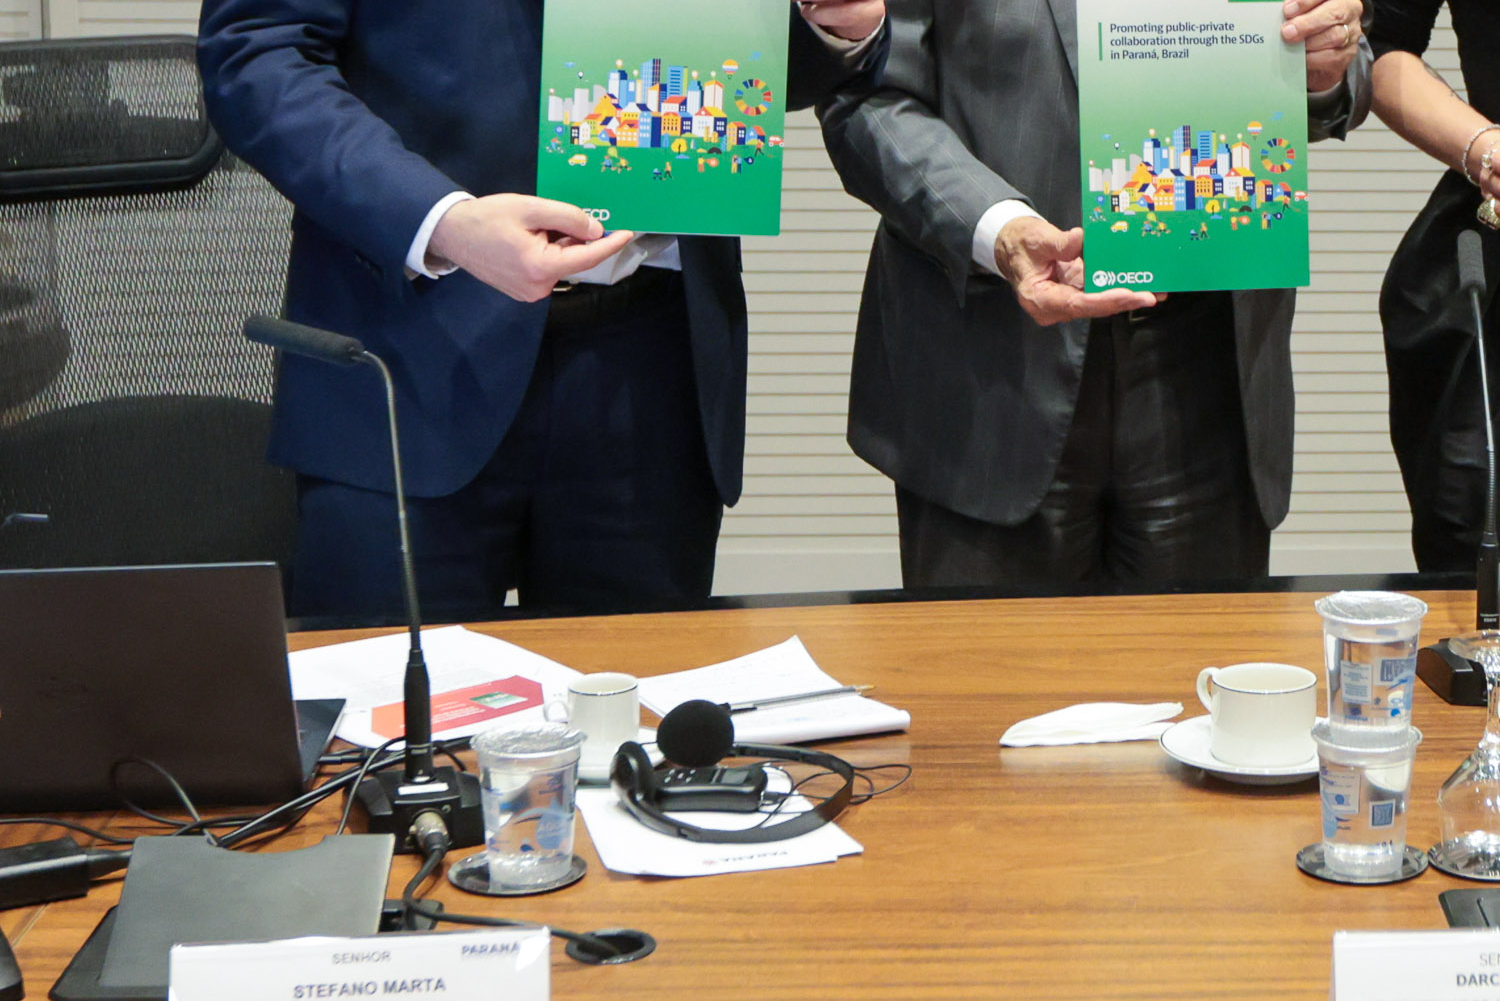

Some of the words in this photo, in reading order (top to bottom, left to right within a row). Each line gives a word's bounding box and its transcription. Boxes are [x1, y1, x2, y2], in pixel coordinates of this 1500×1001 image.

[1110, 22, 1164, 35] Promoting
[1166, 22, 1234, 34] public-private
[1110, 35, 1176, 46] collaboration
[1178, 34, 1218, 47] through
[1220, 34, 1237, 45] the
[1239, 34, 1265, 45] SDGs
[1110, 50, 1120, 60] in
[1122, 49, 1160, 60] Paraná,
[1162, 49, 1189, 59] Brazil
[1117, 271, 1154, 284] OECD
[332, 951, 391, 965] SENHOR
[293, 980, 378, 999] STEFANO
[383, 977, 447, 994] MARTA
